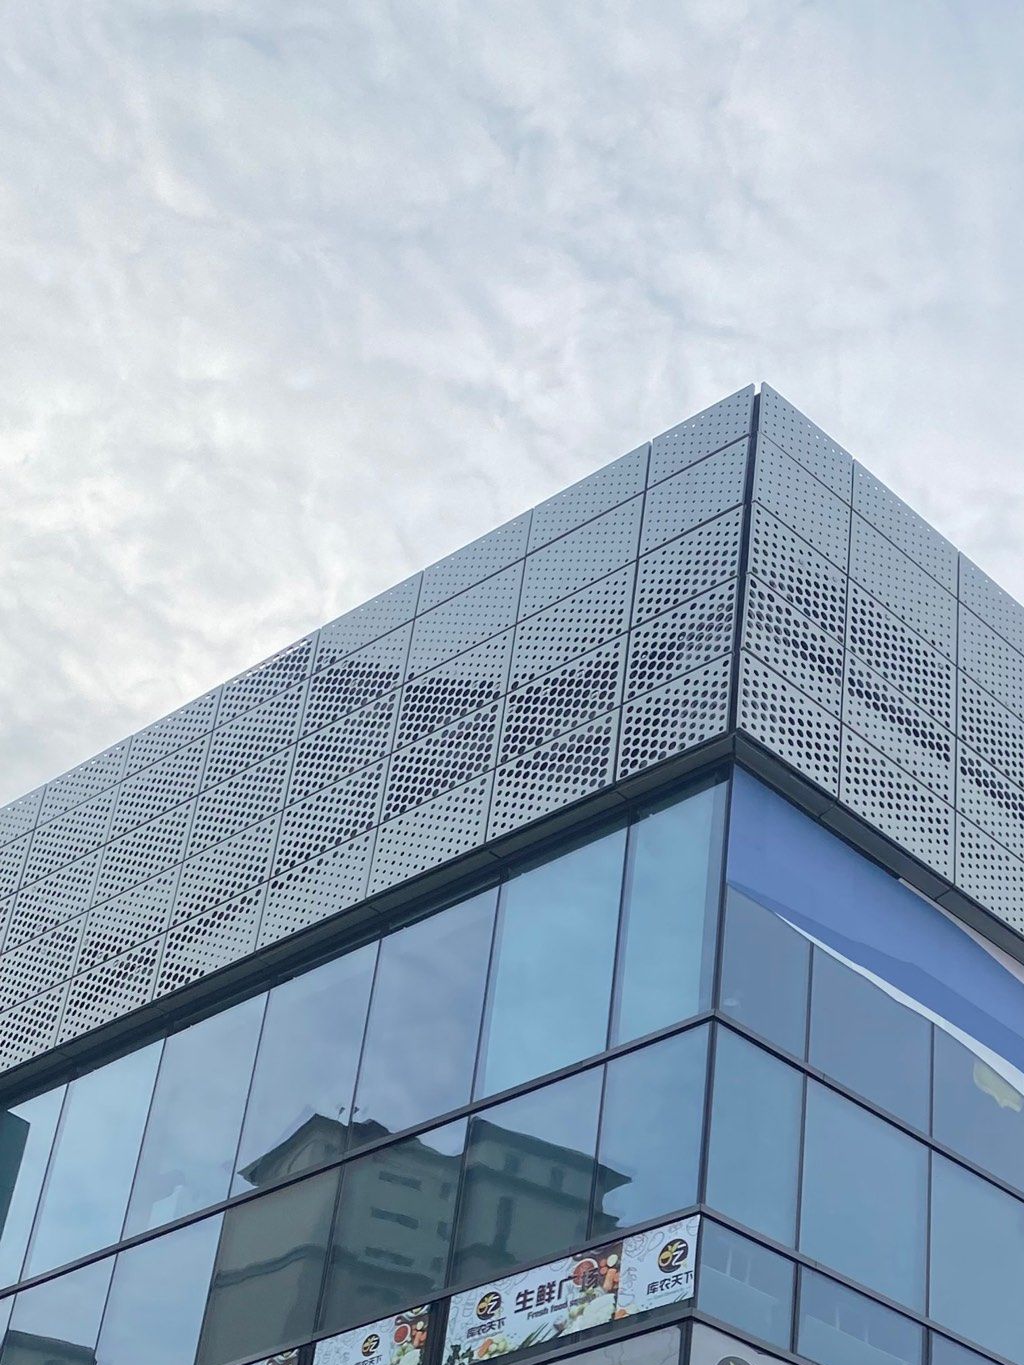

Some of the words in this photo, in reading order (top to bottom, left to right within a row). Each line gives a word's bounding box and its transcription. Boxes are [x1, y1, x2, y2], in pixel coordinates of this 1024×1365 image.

[514, 1267, 600, 1313] 生鲜广场
[646, 1270, 694, 1295] 库农天下
